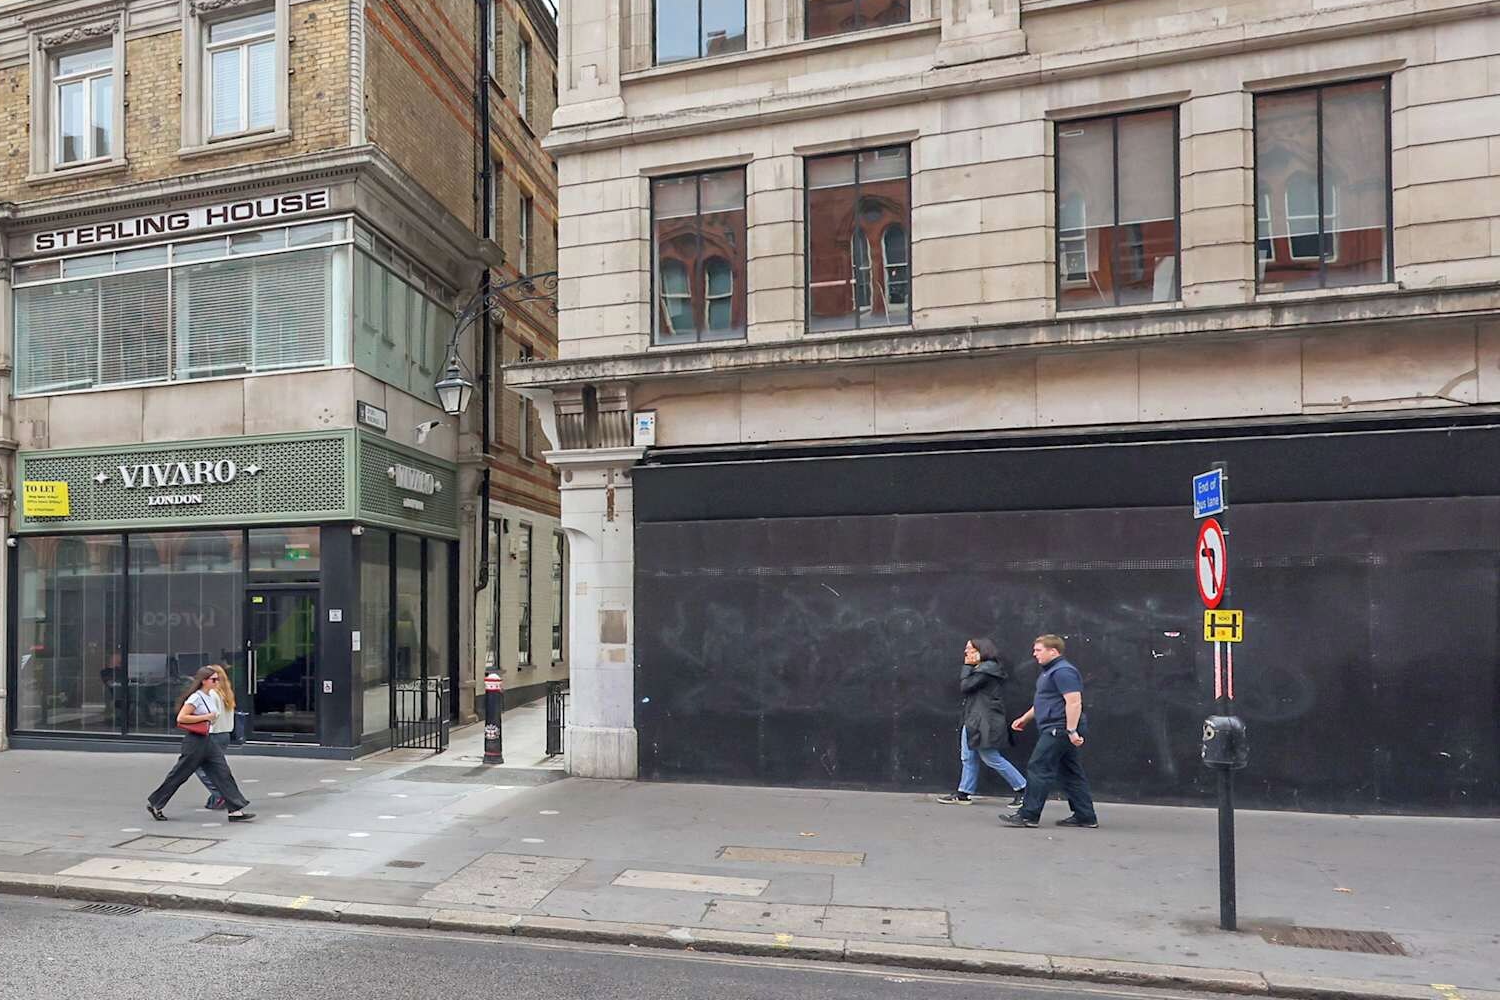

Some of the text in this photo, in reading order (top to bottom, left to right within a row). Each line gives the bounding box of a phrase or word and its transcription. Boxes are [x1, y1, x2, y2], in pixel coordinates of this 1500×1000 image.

[35, 190, 327, 251] STERLING HOUSE
[117, 459, 237, 489] VIVARO
[25, 485, 56, 493] TO LET
[1198, 477, 1217, 494] End of
[148, 494, 203, 506] LONDON
[1197, 496, 1219, 511] bus lane
